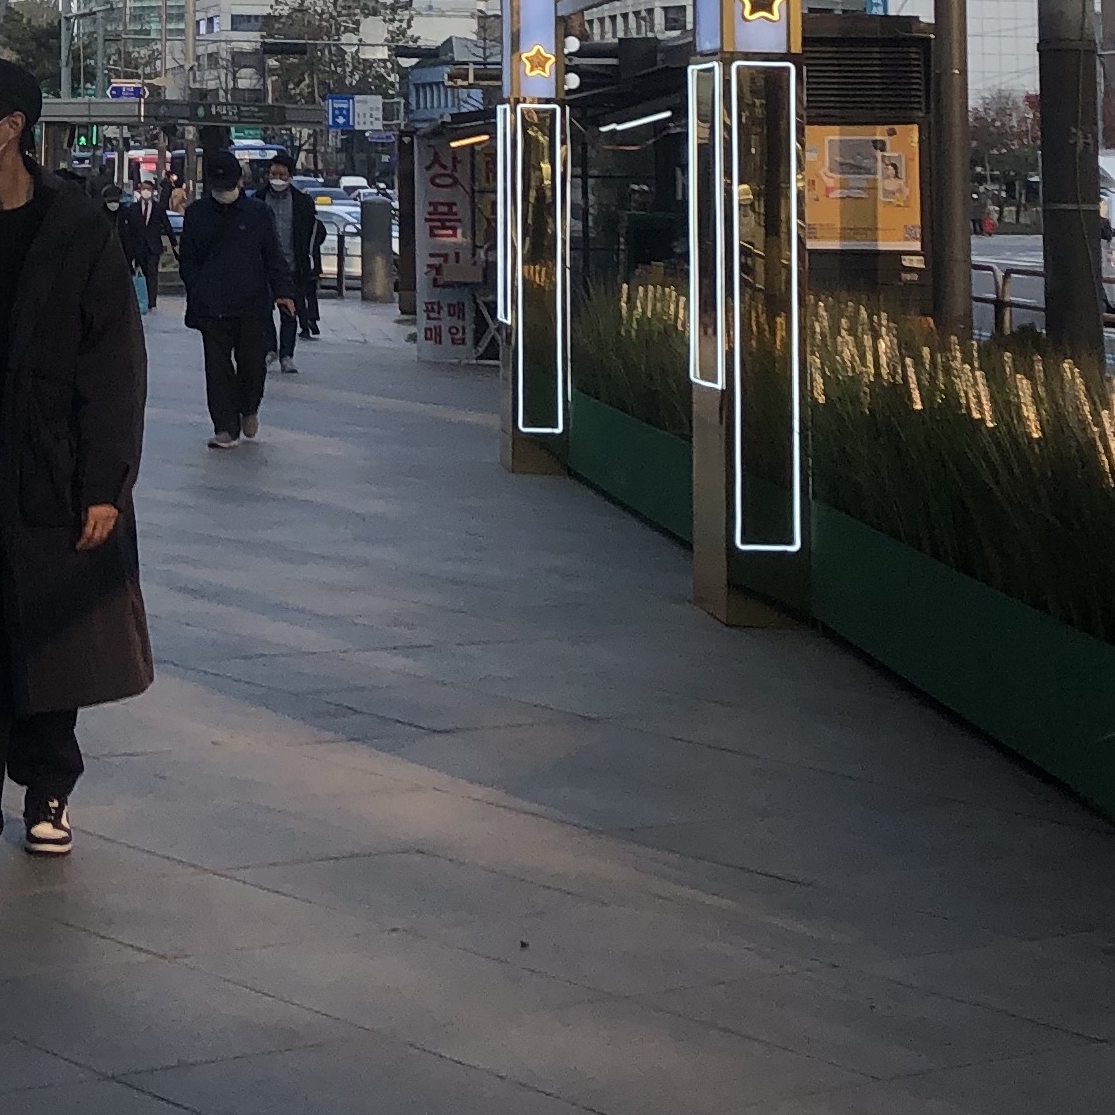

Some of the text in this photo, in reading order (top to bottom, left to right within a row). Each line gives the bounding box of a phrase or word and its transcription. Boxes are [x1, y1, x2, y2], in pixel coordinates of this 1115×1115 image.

[424, 144, 463, 289] 상품권
[423, 300, 467, 322] 판매
[423, 323, 468, 346] 매입
